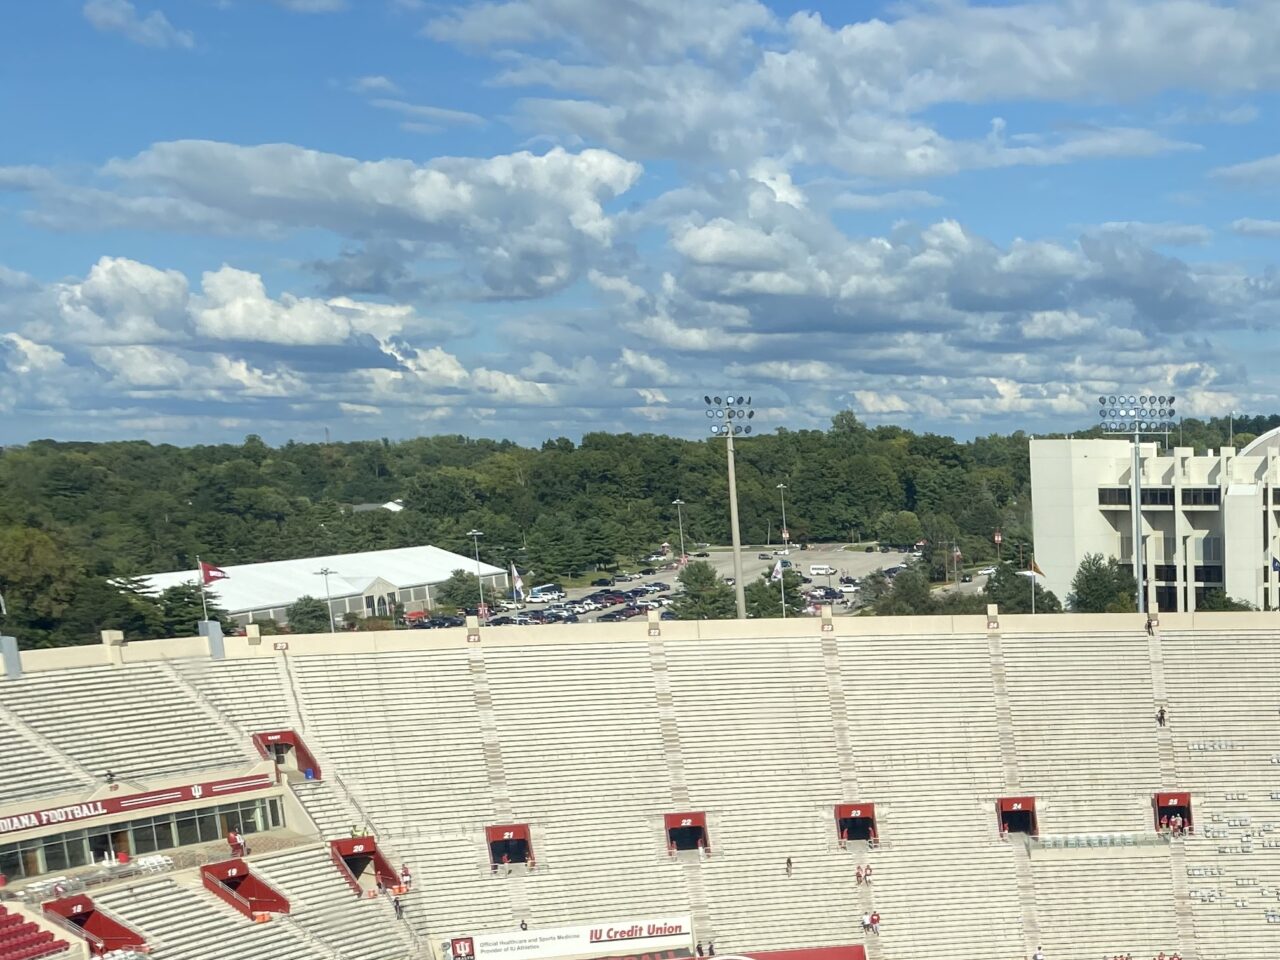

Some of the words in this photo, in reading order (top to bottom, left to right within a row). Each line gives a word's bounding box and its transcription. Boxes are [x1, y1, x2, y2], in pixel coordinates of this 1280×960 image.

[41, 802, 107, 824] FOOTBALL
[227, 868, 237, 876] 19
[590, 929, 602, 941] IU
[607, 927, 643, 940] Credit
[648, 923, 682, 936] Union
[500, 937, 527, 946] Healthcare
[539, 935, 556, 944] Sports
[557, 933, 580, 941] Medicine
[517, 943, 540, 951] Athletics
